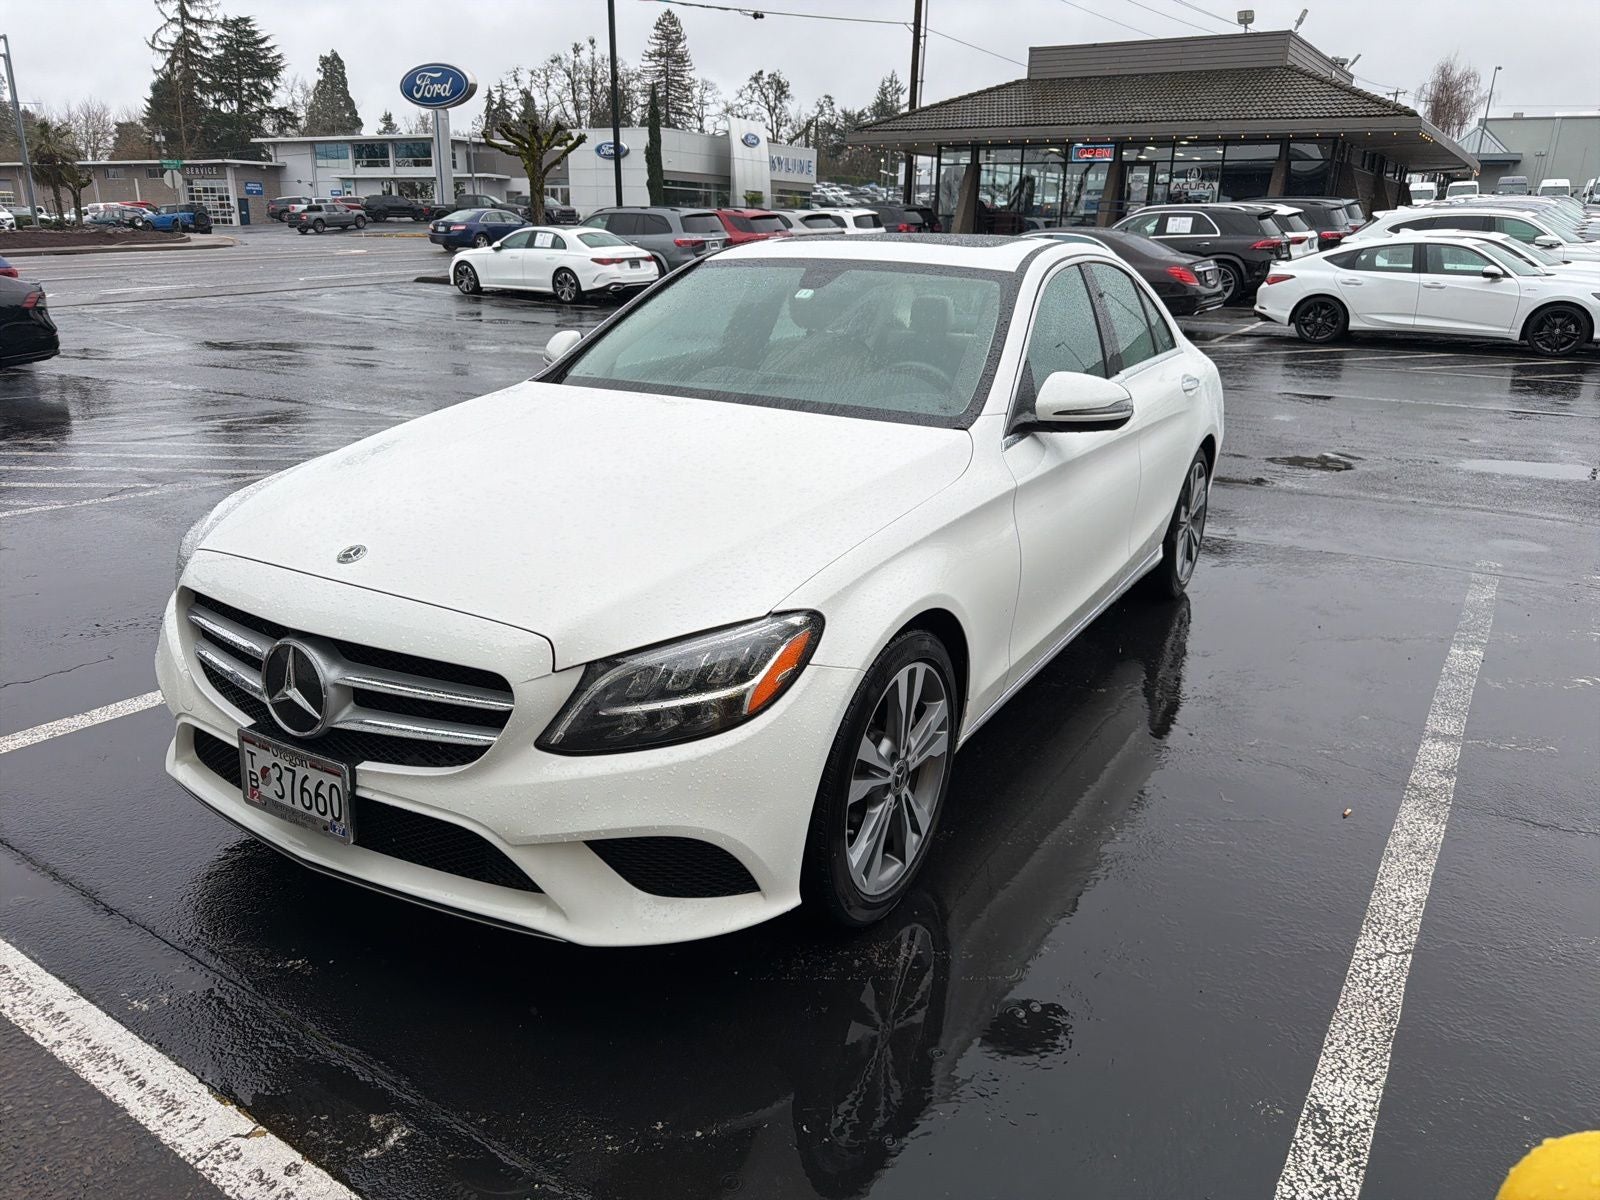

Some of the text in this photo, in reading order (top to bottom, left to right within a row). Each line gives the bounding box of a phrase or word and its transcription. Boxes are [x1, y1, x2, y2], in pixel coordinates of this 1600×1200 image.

[413, 72, 453, 98] Ford
[1078, 148, 1111, 158] OPEN
[186, 167, 217, 175] SERVICE
[770, 155, 813, 176] KYLINE
[1173, 182, 1215, 191] ACURA
[271, 748, 309, 769] Oregon
[271, 762, 342, 822] 37660
